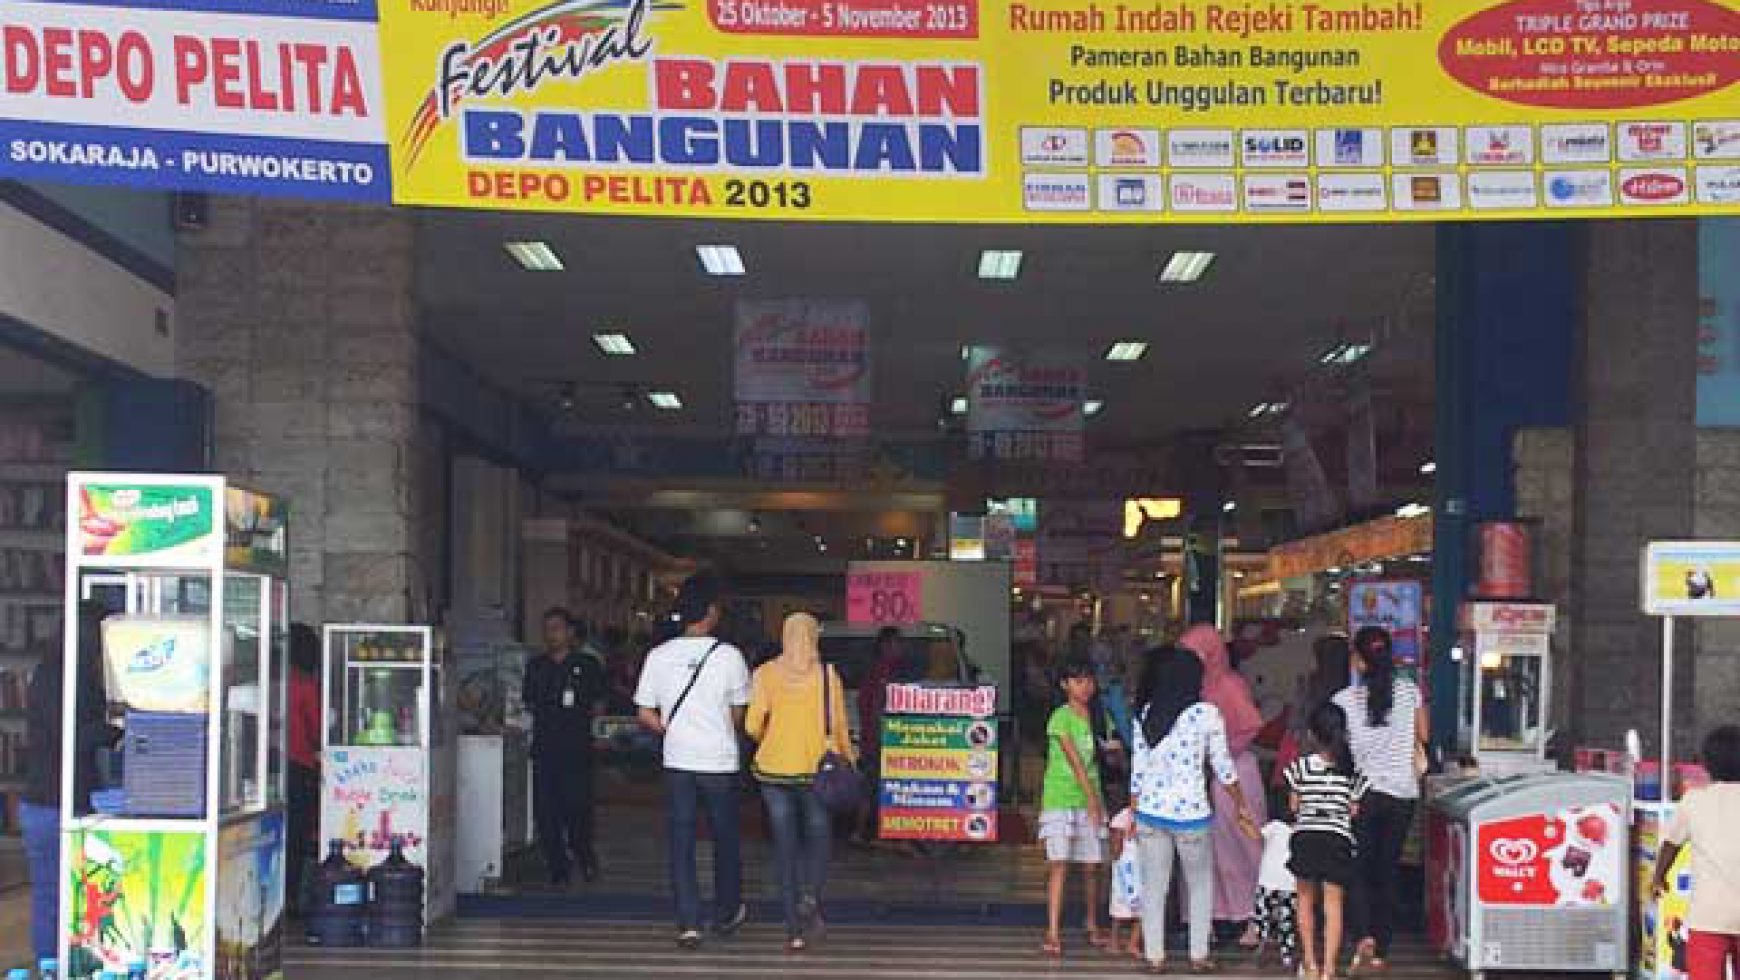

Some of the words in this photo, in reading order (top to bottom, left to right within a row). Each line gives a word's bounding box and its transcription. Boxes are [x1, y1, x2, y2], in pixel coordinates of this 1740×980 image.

[717, 0, 738, 26] 25
[740, 0, 807, 27] Oktober
[821, 1, 833, 28] 5
[838, 1, 920, 30] November
[926, 2, 969, 31] 2013
[1010, 3, 1105, 31] Rumah
[1115, 3, 1196, 31] Indah
[1206, 3, 1293, 37] Rejeki
[1302, 3, 1422, 31] Tambah!
[1515, 15, 1572, 32] TRIPLE
[1579, 13, 1637, 30] GRAND
[1642, 11, 1689, 28] PRIZE
[439, 0, 651, 117] Festival
[1071, 46, 1167, 66] Pameran
[1175, 46, 1241, 66] Bahan
[1250, 46, 1359, 73] Bangunan
[1456, 38, 1517, 57] Mobil,
[1522, 37, 1564, 55] LCD
[1607, 35, 1681, 55] Sepeda
[3, 25, 154, 104] DEPO
[174, 35, 367, 117] PELITA
[654, 59, 979, 116] BAHAN
[1049, 79, 1136, 104] Produk
[1146, 79, 1265, 110] Unggulan
[1275, 79, 1382, 104] Terbaru!
[465, 110, 980, 172] BANGUNAN
[10, 140, 159, 169] SOKARAJA
[183, 151, 373, 184] PURWOKERTO
[468, 171, 569, 199] DEPO
[584, 175, 712, 205] PELITA
[725, 180, 811, 208] 2013
[887, 684, 995, 717] Dilarang!
